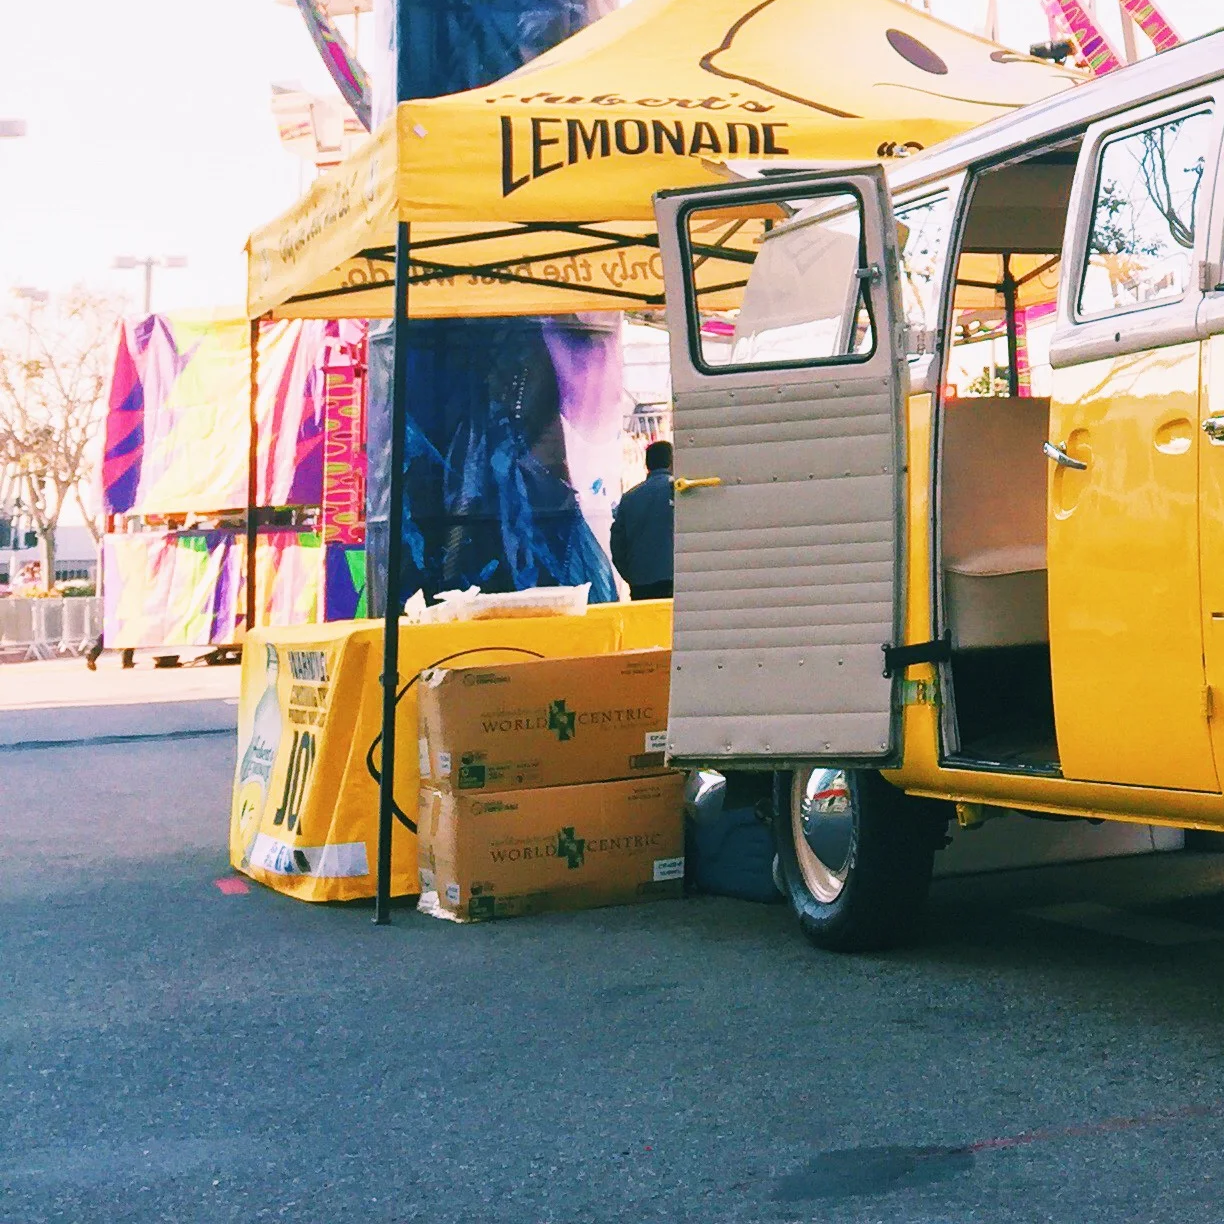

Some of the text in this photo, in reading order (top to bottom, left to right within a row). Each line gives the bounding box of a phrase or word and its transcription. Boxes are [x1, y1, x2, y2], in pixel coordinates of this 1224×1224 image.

[482, 707, 655, 734] WORLD CENTRIC
[489, 832, 662, 864] WORLD CENTRIC
